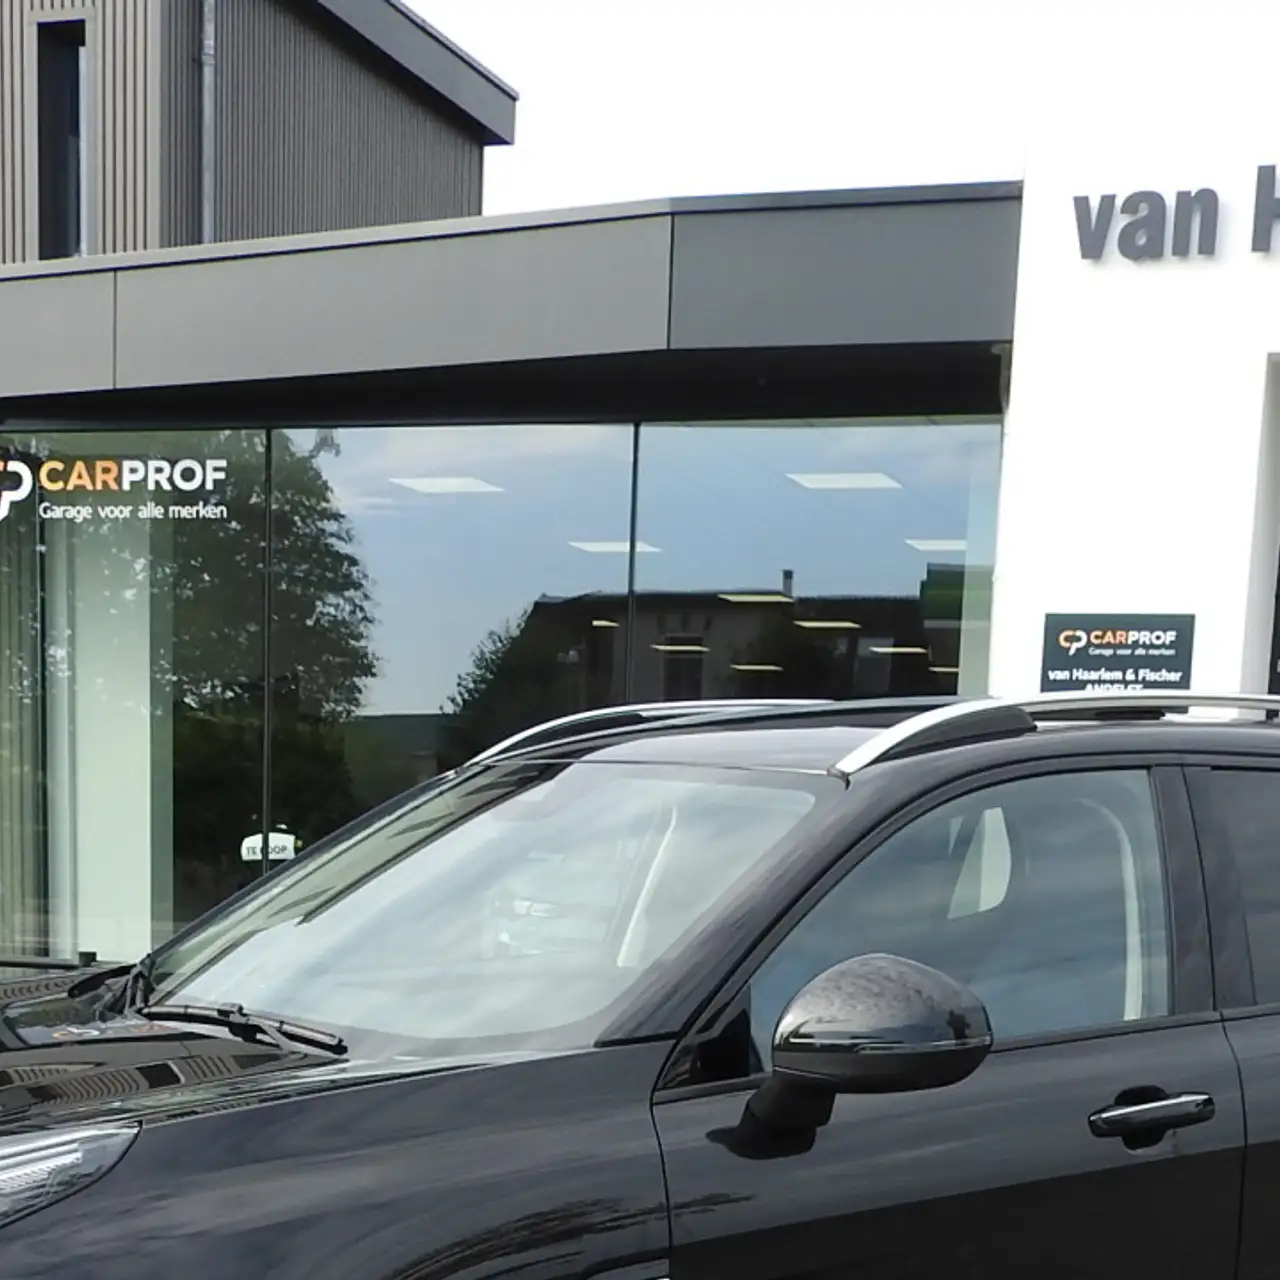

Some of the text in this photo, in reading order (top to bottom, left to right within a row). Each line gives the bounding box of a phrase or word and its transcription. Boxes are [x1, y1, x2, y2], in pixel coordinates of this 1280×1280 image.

[1072, 184, 1219, 261] van
[39, 459, 227, 491] CARPROF
[39, 501, 227, 521] Garage voor alle merken
[1090, 630, 1177, 645] CARPROF
[1048, 668, 1183, 682] van Haarlem & Fischer
